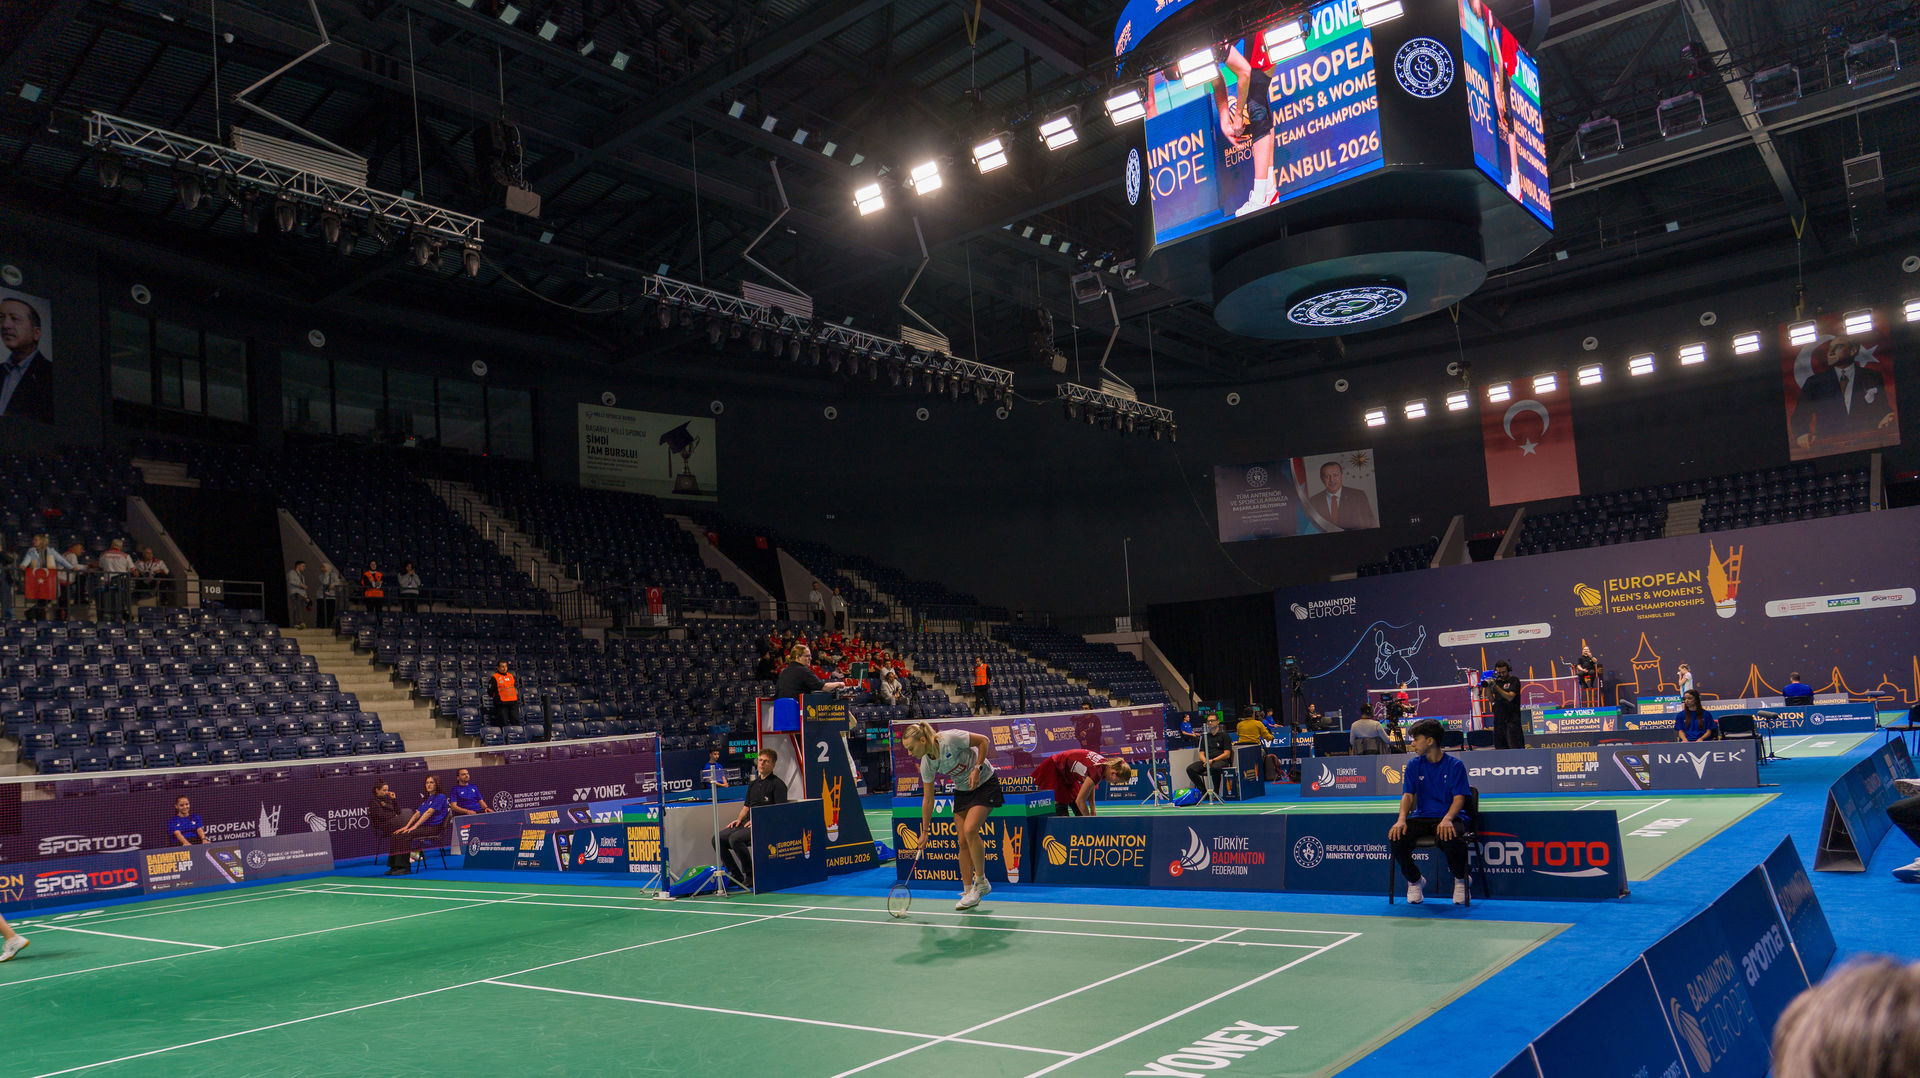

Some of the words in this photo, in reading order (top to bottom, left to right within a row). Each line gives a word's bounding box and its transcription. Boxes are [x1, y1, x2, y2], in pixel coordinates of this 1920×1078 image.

[1269, 37, 1374, 103] EUROPEA
[1273, 99, 1315, 126] MEN'S
[1318, 91, 1328, 108] &
[1331, 69, 1377, 101] WOME
[1276, 125, 1306, 147] TEAM
[1308, 95, 1378, 135] CHAMPIONS
[1339, 130, 1380, 164] 2026
[586, 433, 609, 446] ŞİMDİ
[586, 445, 602, 455] TAM
[605, 447, 638, 459] BURSLU!
[1609, 569, 1701, 591] EUROPEAN
[204, 585, 221, 594] 108
[1611, 593, 1641, 603] MEN'S
[1643, 591, 1651, 600] &
[1653, 586, 1703, 599] WOMEN'S
[1308, 596, 1356, 609] BADMINTON
[1612, 605, 1634, 613] TEAM
[1635, 598, 1705, 611] CHAMPIONSHIPS
[1309, 603, 1356, 619] EUROPE
[1575, 609, 1602, 617] EUROPE
[1561, 718, 1600, 726] EUROPEAN
[816, 741, 830, 762] 2
[1556, 752, 1598, 763] BADMINTON
[1336, 767, 1358, 775] TÜRKİYE
[1468, 764, 1540, 777] aroma
[1557, 762, 1584, 772] EUROPE
[1585, 762, 1599, 771] APP
[1658, 751, 1741, 779] NAVEK
[593, 784, 626, 799] YONEX
[642, 779, 693, 793] SPRTOTO
[627, 826, 660, 841] BADMINTON
[1070, 835, 1146, 847] BADMINTON
[38, 834, 142, 855] SPORTOTO
[926, 840, 949, 848] MEN'S
[950, 840, 957, 848] &
[1213, 835, 1249, 850] TÜRKİYE
[1326, 844, 1353, 852] REPUBLIC
[1363, 843, 1387, 851] TÜRKİYE
[147, 851, 190, 866] BADMINTON
[628, 841, 661, 861] EUROPE
[854, 853, 871, 864] 2026
[1068, 849, 1144, 867] EUROPE
[147, 862, 179, 875] EUROPE
[179, 860, 194, 872] APP
[914, 867, 958, 881] İSTANBUL
[1211, 865, 1248, 876] FEDERATION
[35, 868, 138, 894] SPORTOTO
[1741, 924, 1785, 987] aroma
[1686, 952, 1736, 1013] BADMINTON
[1699, 981, 1754, 1064] EUROPE
[1125, 1019, 1300, 1078] YONEX
